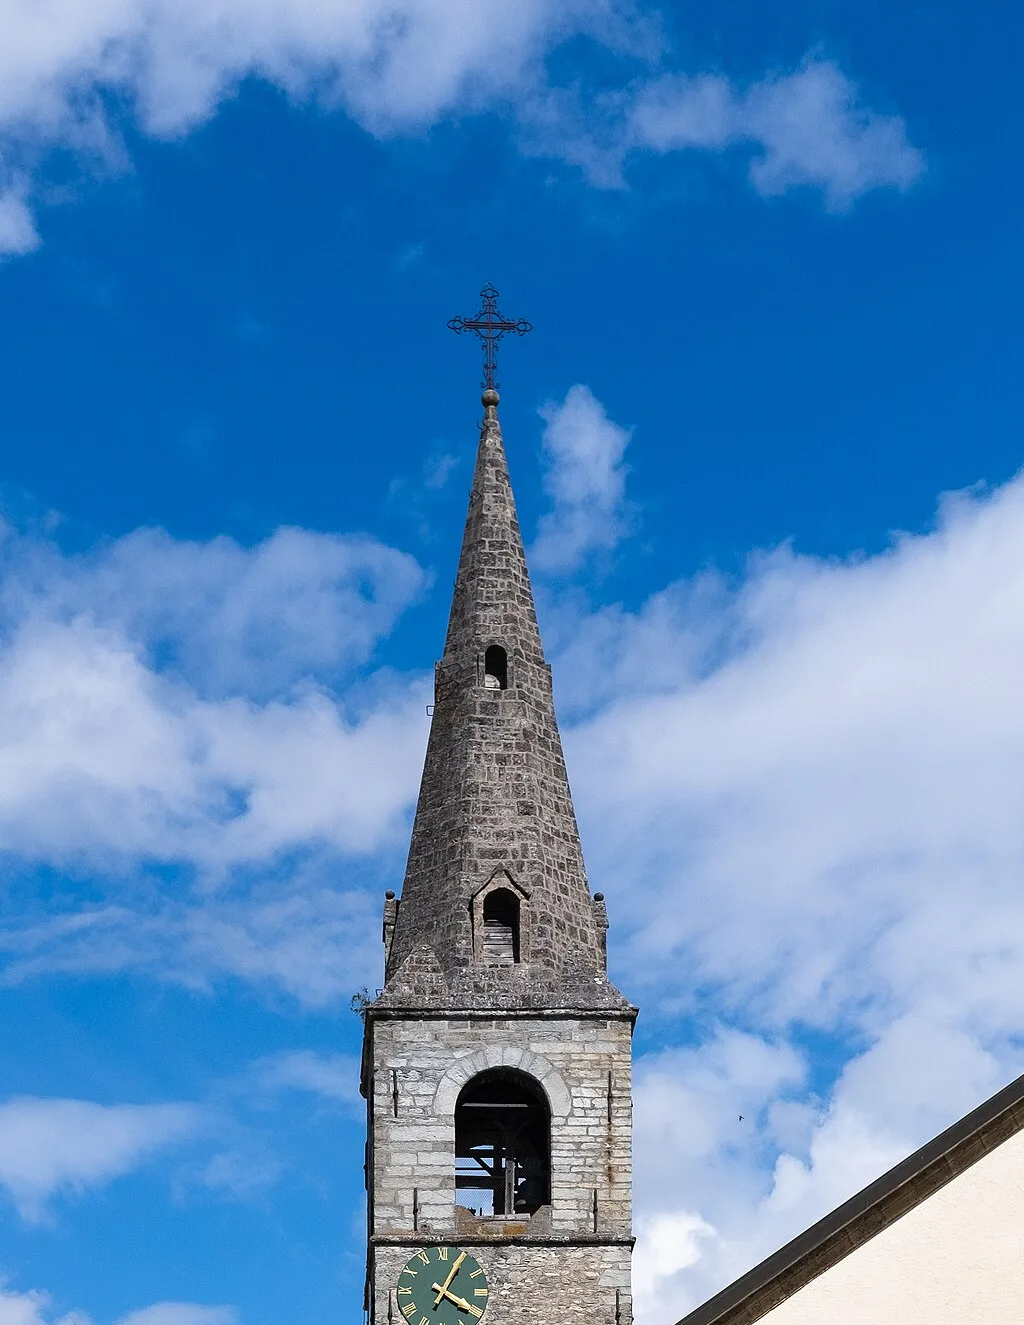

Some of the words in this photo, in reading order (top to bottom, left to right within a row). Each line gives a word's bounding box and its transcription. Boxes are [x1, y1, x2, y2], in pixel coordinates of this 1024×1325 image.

[417, 1251, 430, 1266] XI
[437, 1247, 448, 1260] XII
[403, 1265, 418, 1278] X
[469, 1268, 483, 1278] II
[398, 1285, 412, 1295] IX
[473, 1288, 488, 1296] III
[402, 1301, 418, 1318] VIII
